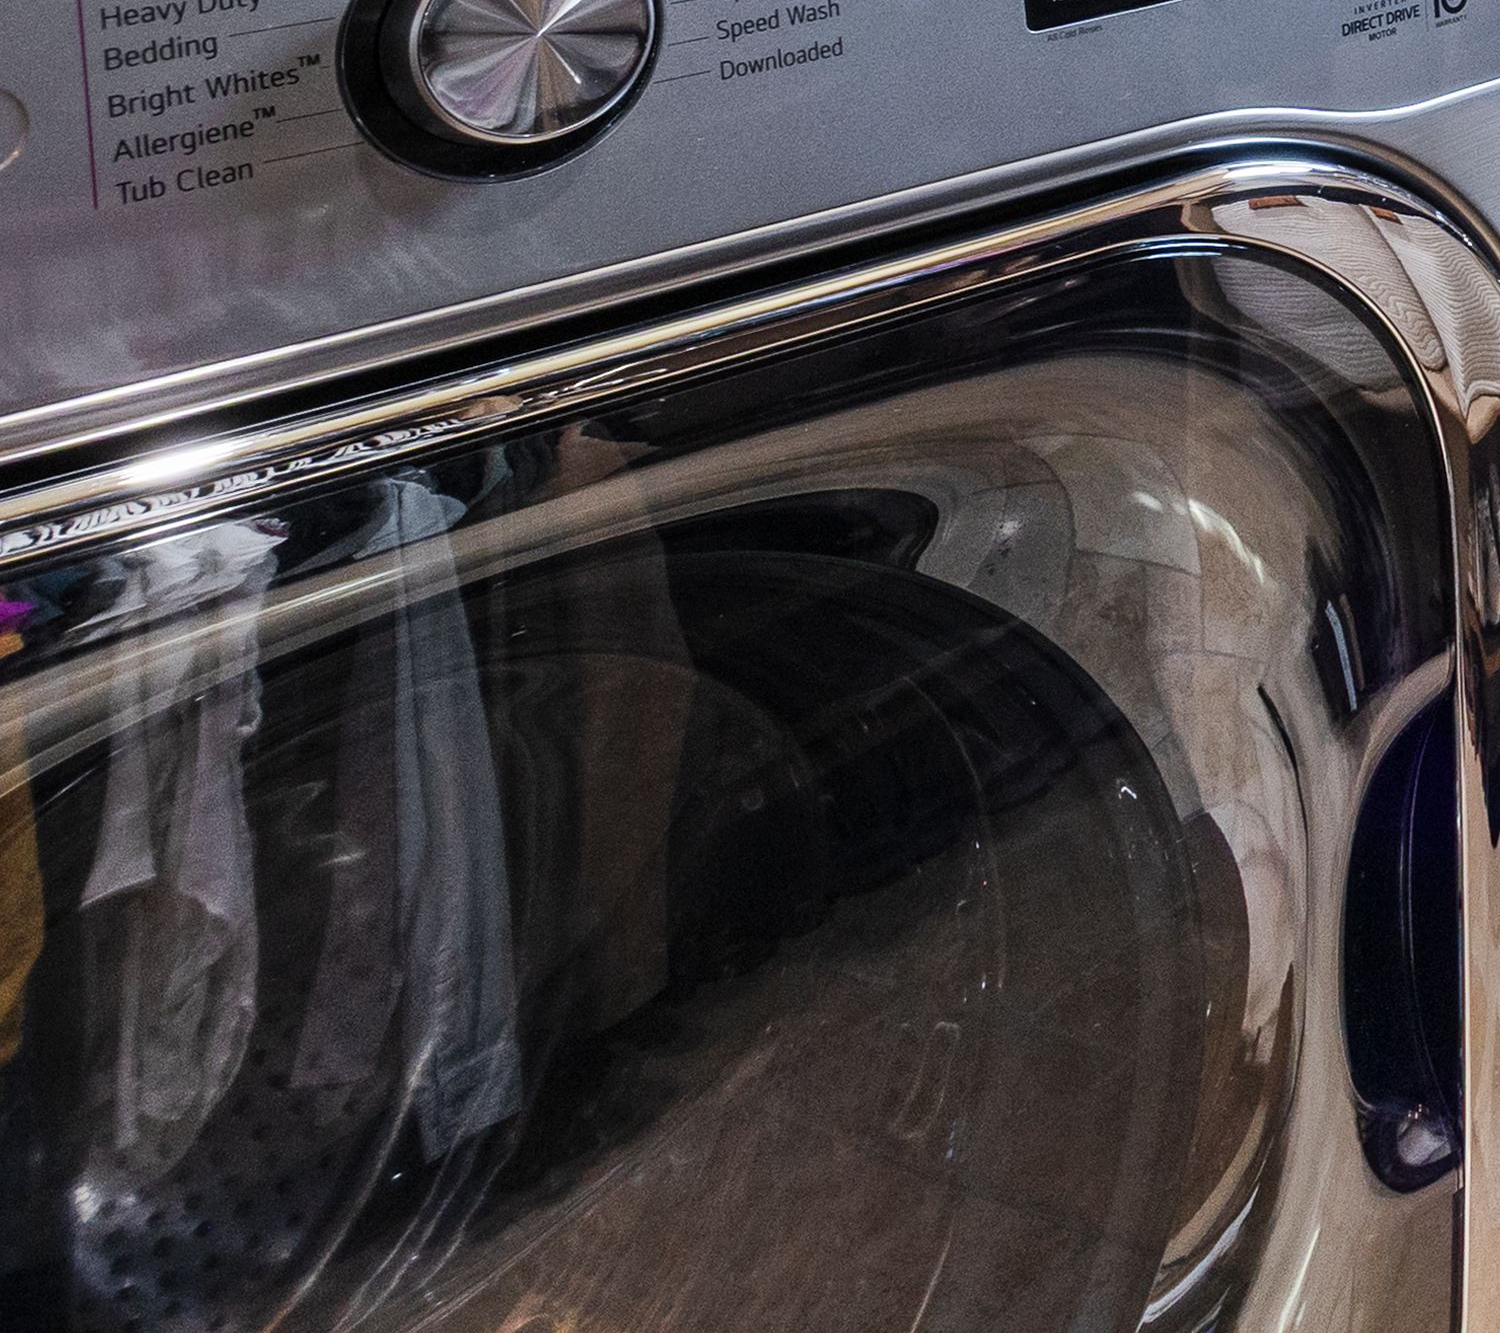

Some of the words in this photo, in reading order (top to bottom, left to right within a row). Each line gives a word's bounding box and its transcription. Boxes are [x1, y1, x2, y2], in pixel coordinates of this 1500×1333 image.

[100, 1, 188, 29] Heavy
[716, 9, 780, 43] Speed
[786, 0, 840, 26] Wash
[1342, 13, 1384, 37] DIRECT
[1386, 4, 1421, 25] DRIVE
[1369, 27, 1397, 41] MOTOR
[103, 35, 218, 71] Bedding
[720, 37, 844, 81] Downloaded
[108, 85, 196, 119] Bright
[116, 176, 166, 205] Tub
[176, 162, 254, 193] Clean
